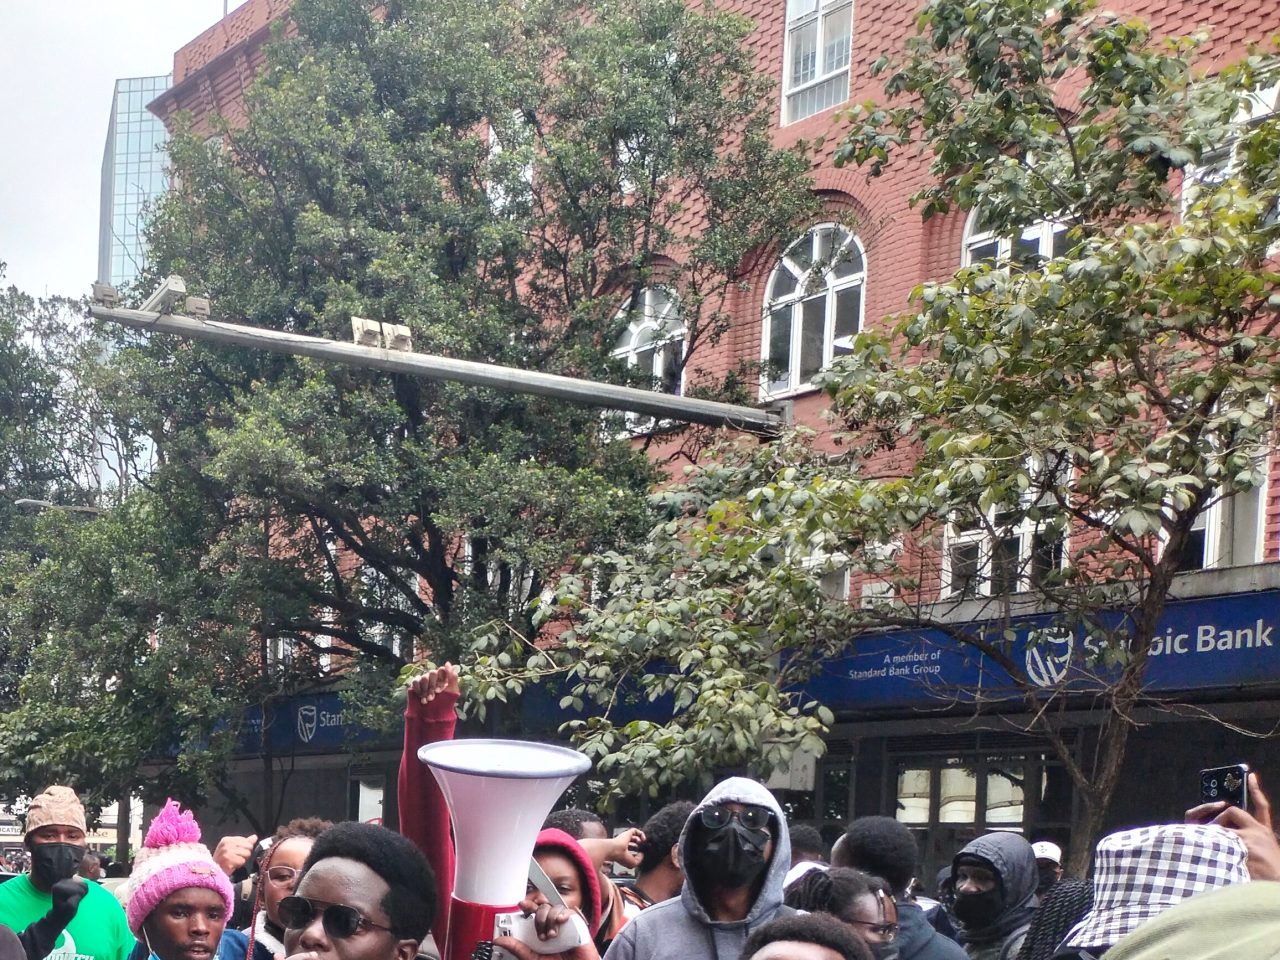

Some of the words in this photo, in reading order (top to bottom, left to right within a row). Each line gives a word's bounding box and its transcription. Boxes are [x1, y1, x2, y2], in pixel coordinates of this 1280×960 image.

[1196, 619, 1274, 653] Bank
[884, 654, 890, 664] A
[892, 652, 928, 664] member
[930, 650, 941, 661] of
[849, 666, 887, 680] Standard
[889, 663, 910, 676] Bank
[913, 663, 941, 676] Group
